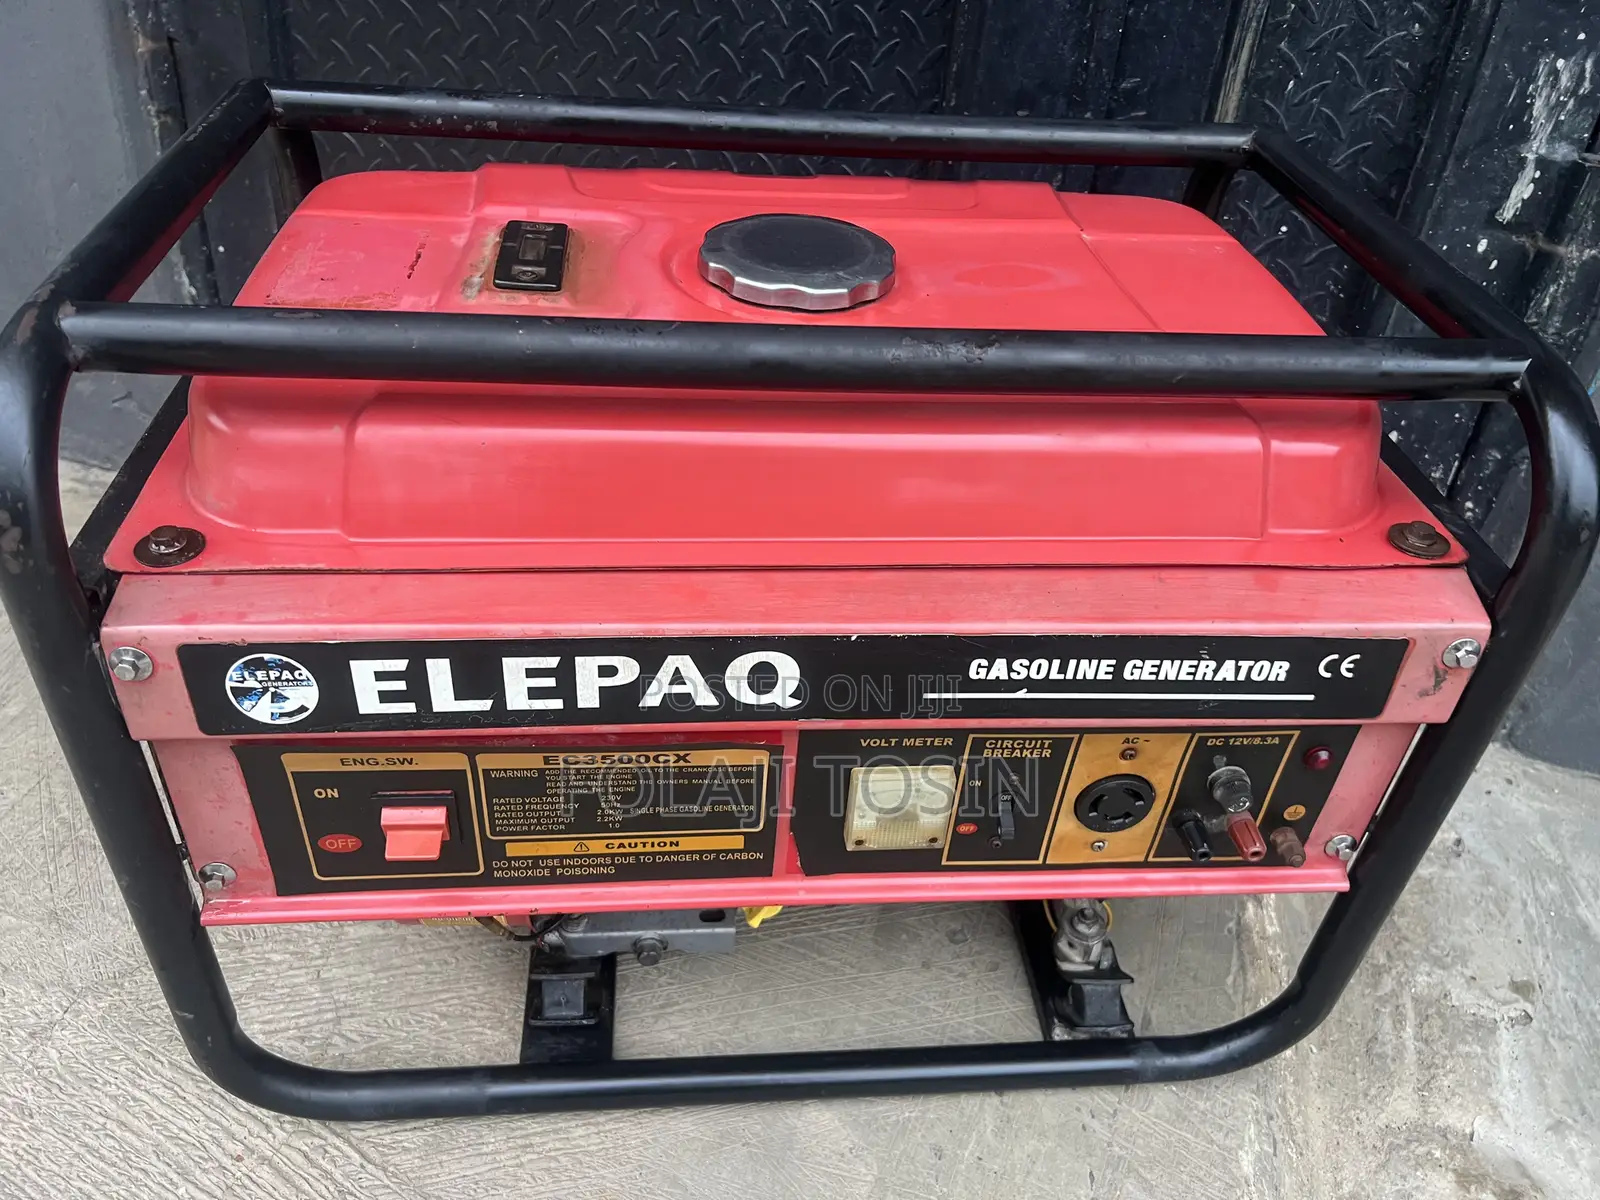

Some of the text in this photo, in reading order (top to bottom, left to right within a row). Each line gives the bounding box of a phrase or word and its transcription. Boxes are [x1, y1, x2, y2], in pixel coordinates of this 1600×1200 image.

[968, 658, 1291, 682] GASOLINE GENERATOR
[1317, 653, 1362, 679] CE
[231, 670, 308, 681] ELEPAQ
[349, 651, 802, 715] ELEPAQ
[860, 737, 954, 747] VOLT METER
[985, 740, 1053, 749] CIRCUIT
[1121, 737, 1140, 745] AC
[1206, 736, 1280, 746] DC 12V/8.3A
[982, 748, 1052, 758] BREAKER
[340, 757, 419, 767] ENG.SW.
[490, 769, 539, 779] WARNING
[313, 788, 340, 799] ON
[546, 787, 588, 795] OPERATING
[525, 803, 580, 811] FREQUENCY
[630, 806, 654, 815] SINGLE
[655, 806, 678, 814] PHASE
[679, 805, 713, 813] GASOLINE
[714, 804, 756, 812] GENERATOR
[325, 838, 357, 850] OFF
[604, 840, 681, 850] CAUTION
[492, 852, 765, 868] DO NOT USE INDOORS DUE TO DANGER OF CARBON
[493, 866, 616, 878] MONOXIDE POISONING
